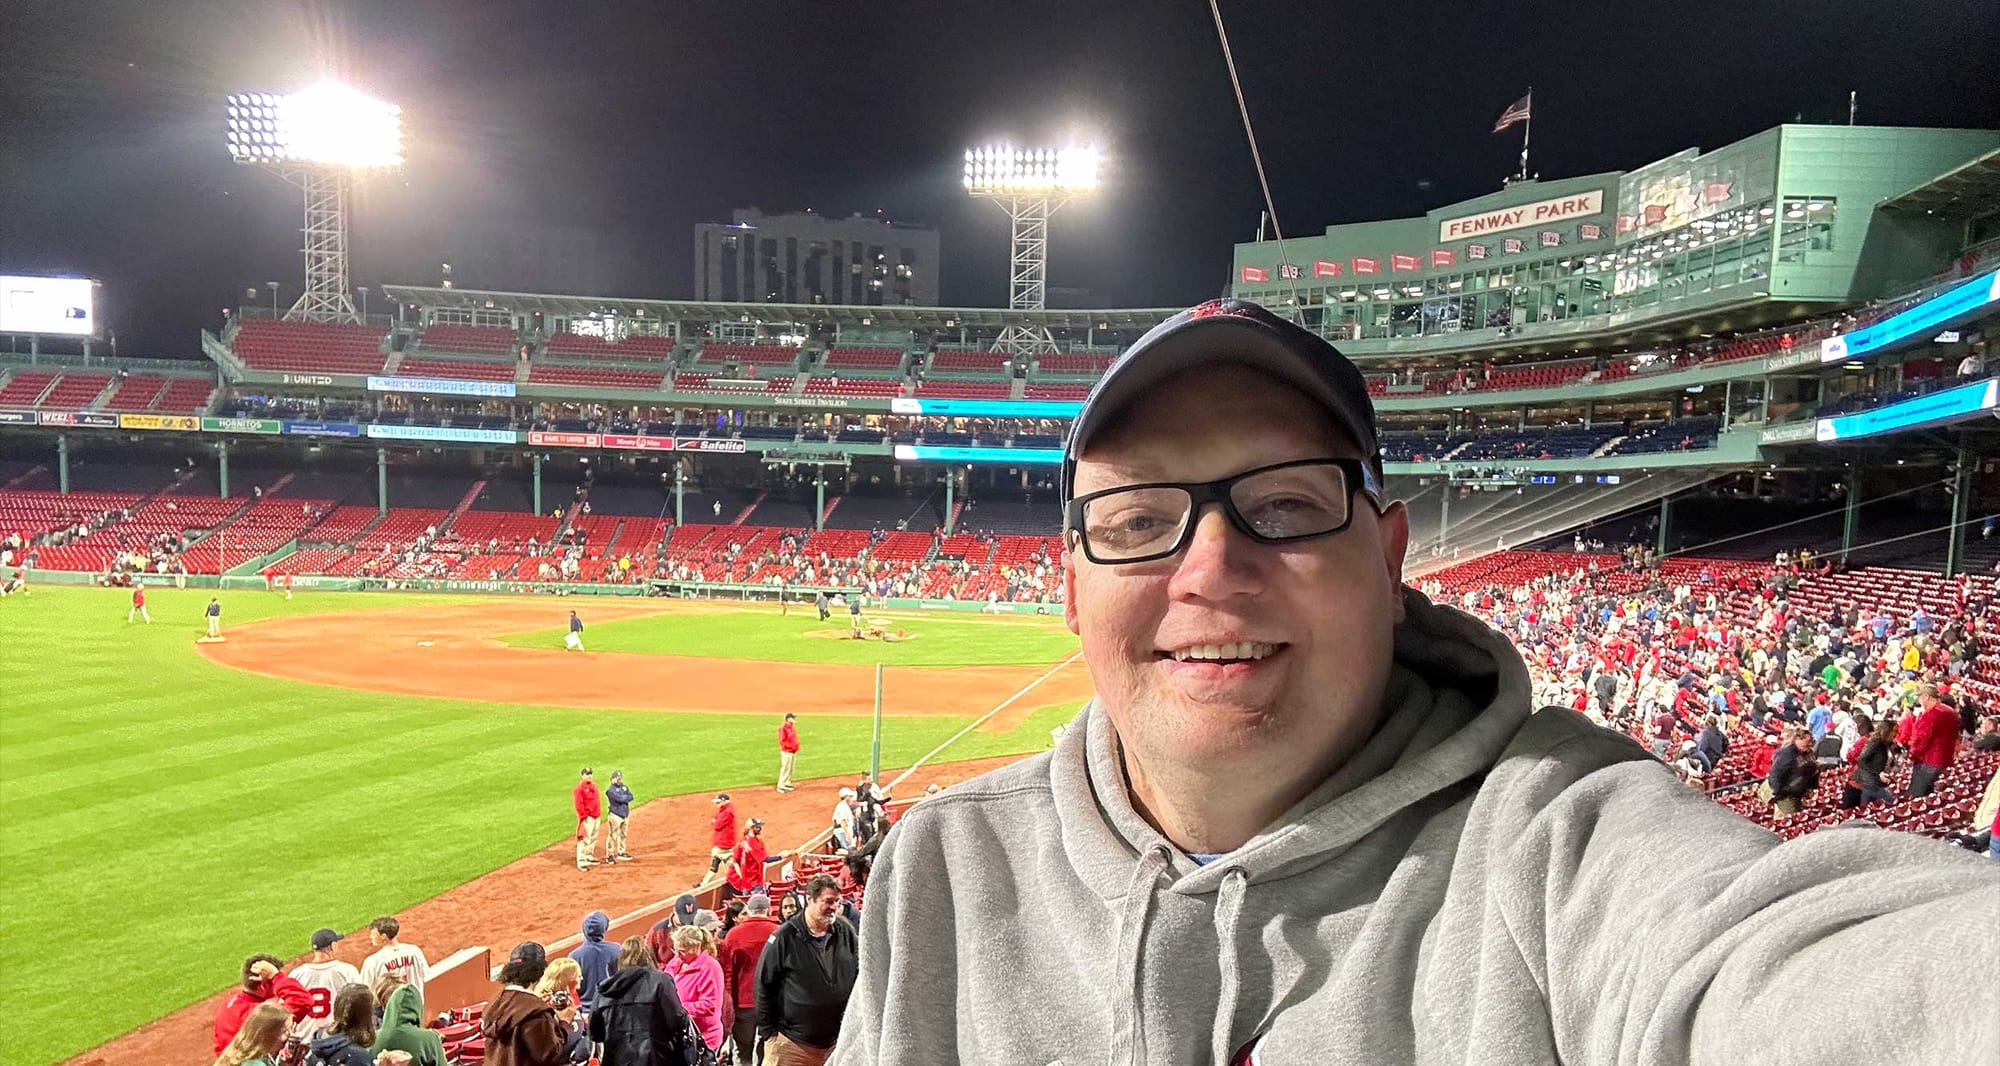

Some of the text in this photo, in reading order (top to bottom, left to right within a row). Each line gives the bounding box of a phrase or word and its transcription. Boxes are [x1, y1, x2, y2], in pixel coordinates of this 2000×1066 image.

[1449, 197, 1590, 237] FENWAY PARK
[293, 374, 333, 385] UNITED
[219, 419, 262, 429] HORNITOS
[700, 440, 743, 450] Safelite
[385, 955, 414, 972] MOLINA
[307, 987, 331, 1019] 8
